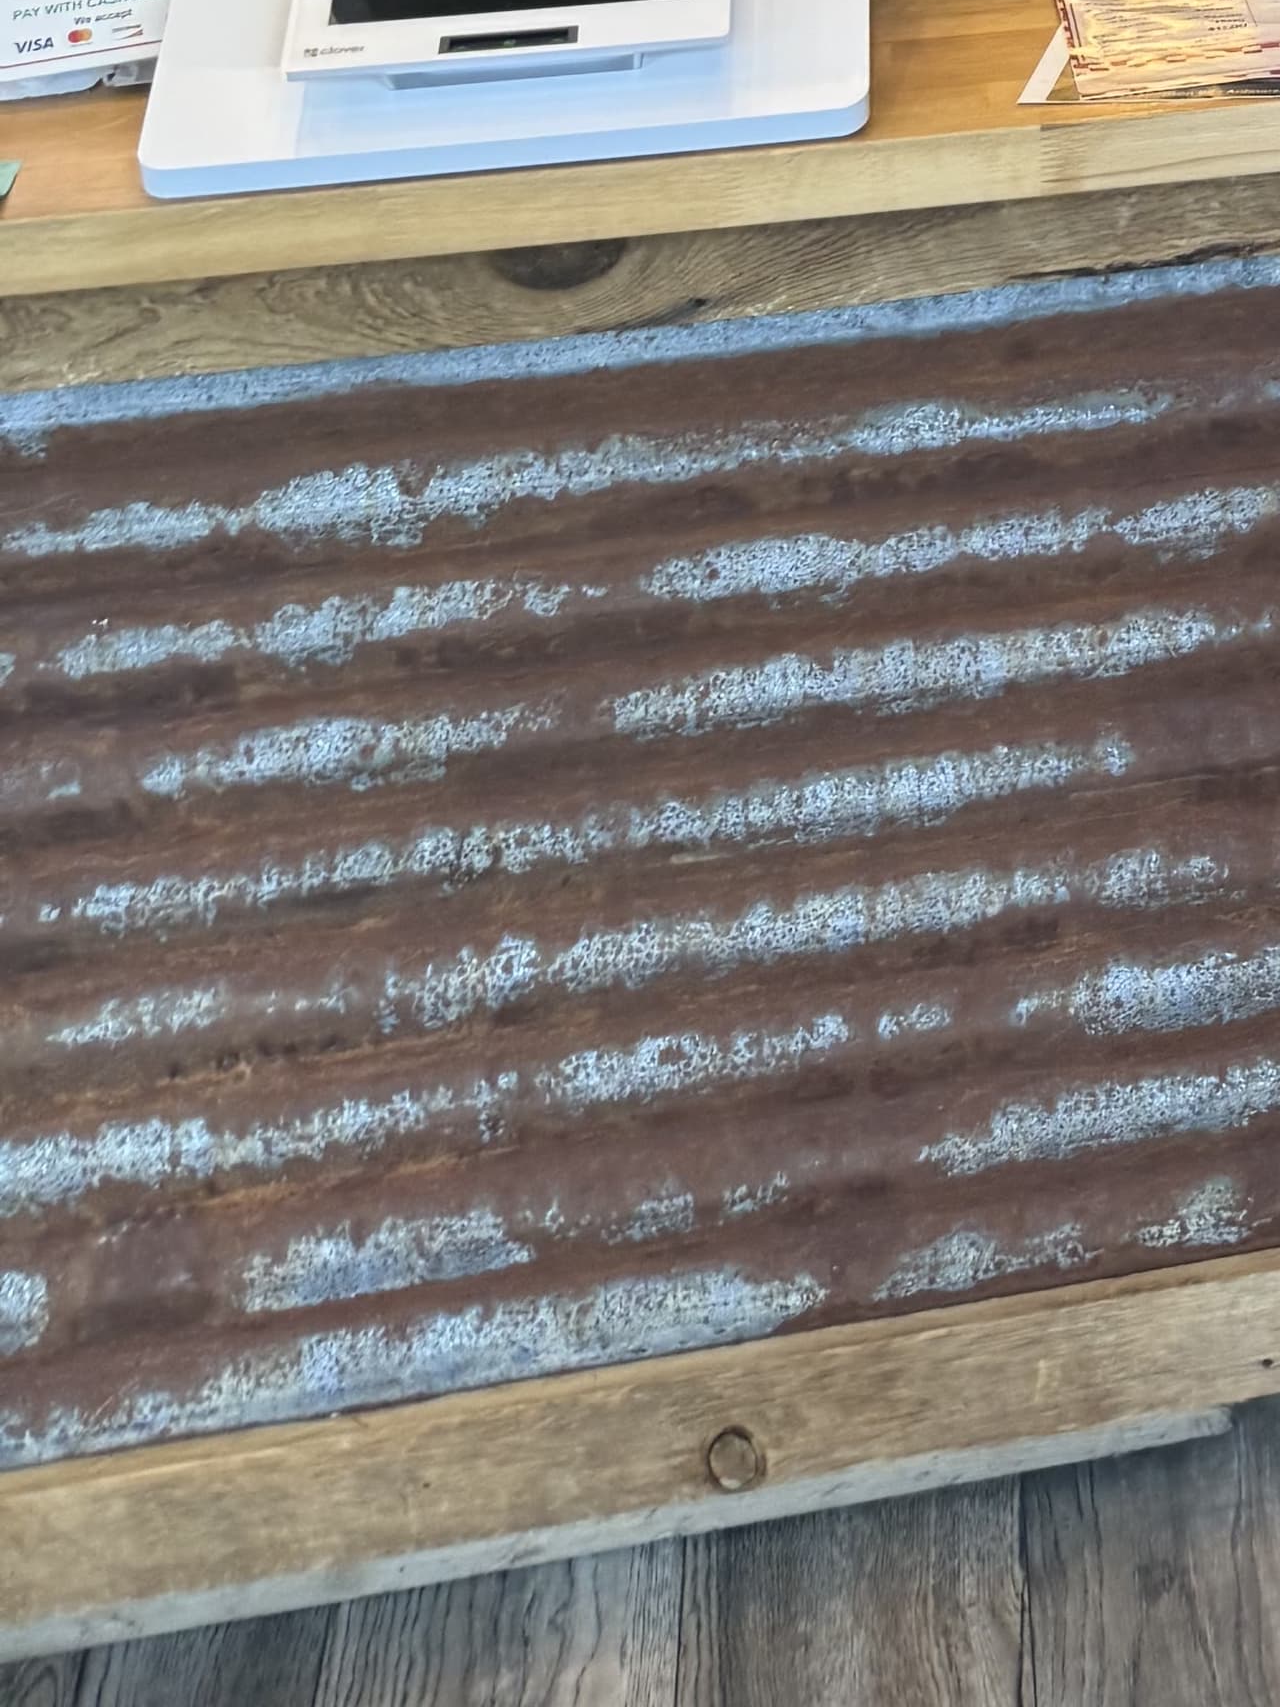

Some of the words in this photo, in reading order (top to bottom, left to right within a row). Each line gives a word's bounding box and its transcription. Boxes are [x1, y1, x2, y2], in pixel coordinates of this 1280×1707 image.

[12, 7, 41, 21] PAY
[45, 0, 83, 14] WITH
[74, 15, 91, 25] We
[15, 37, 54, 54] VISA
